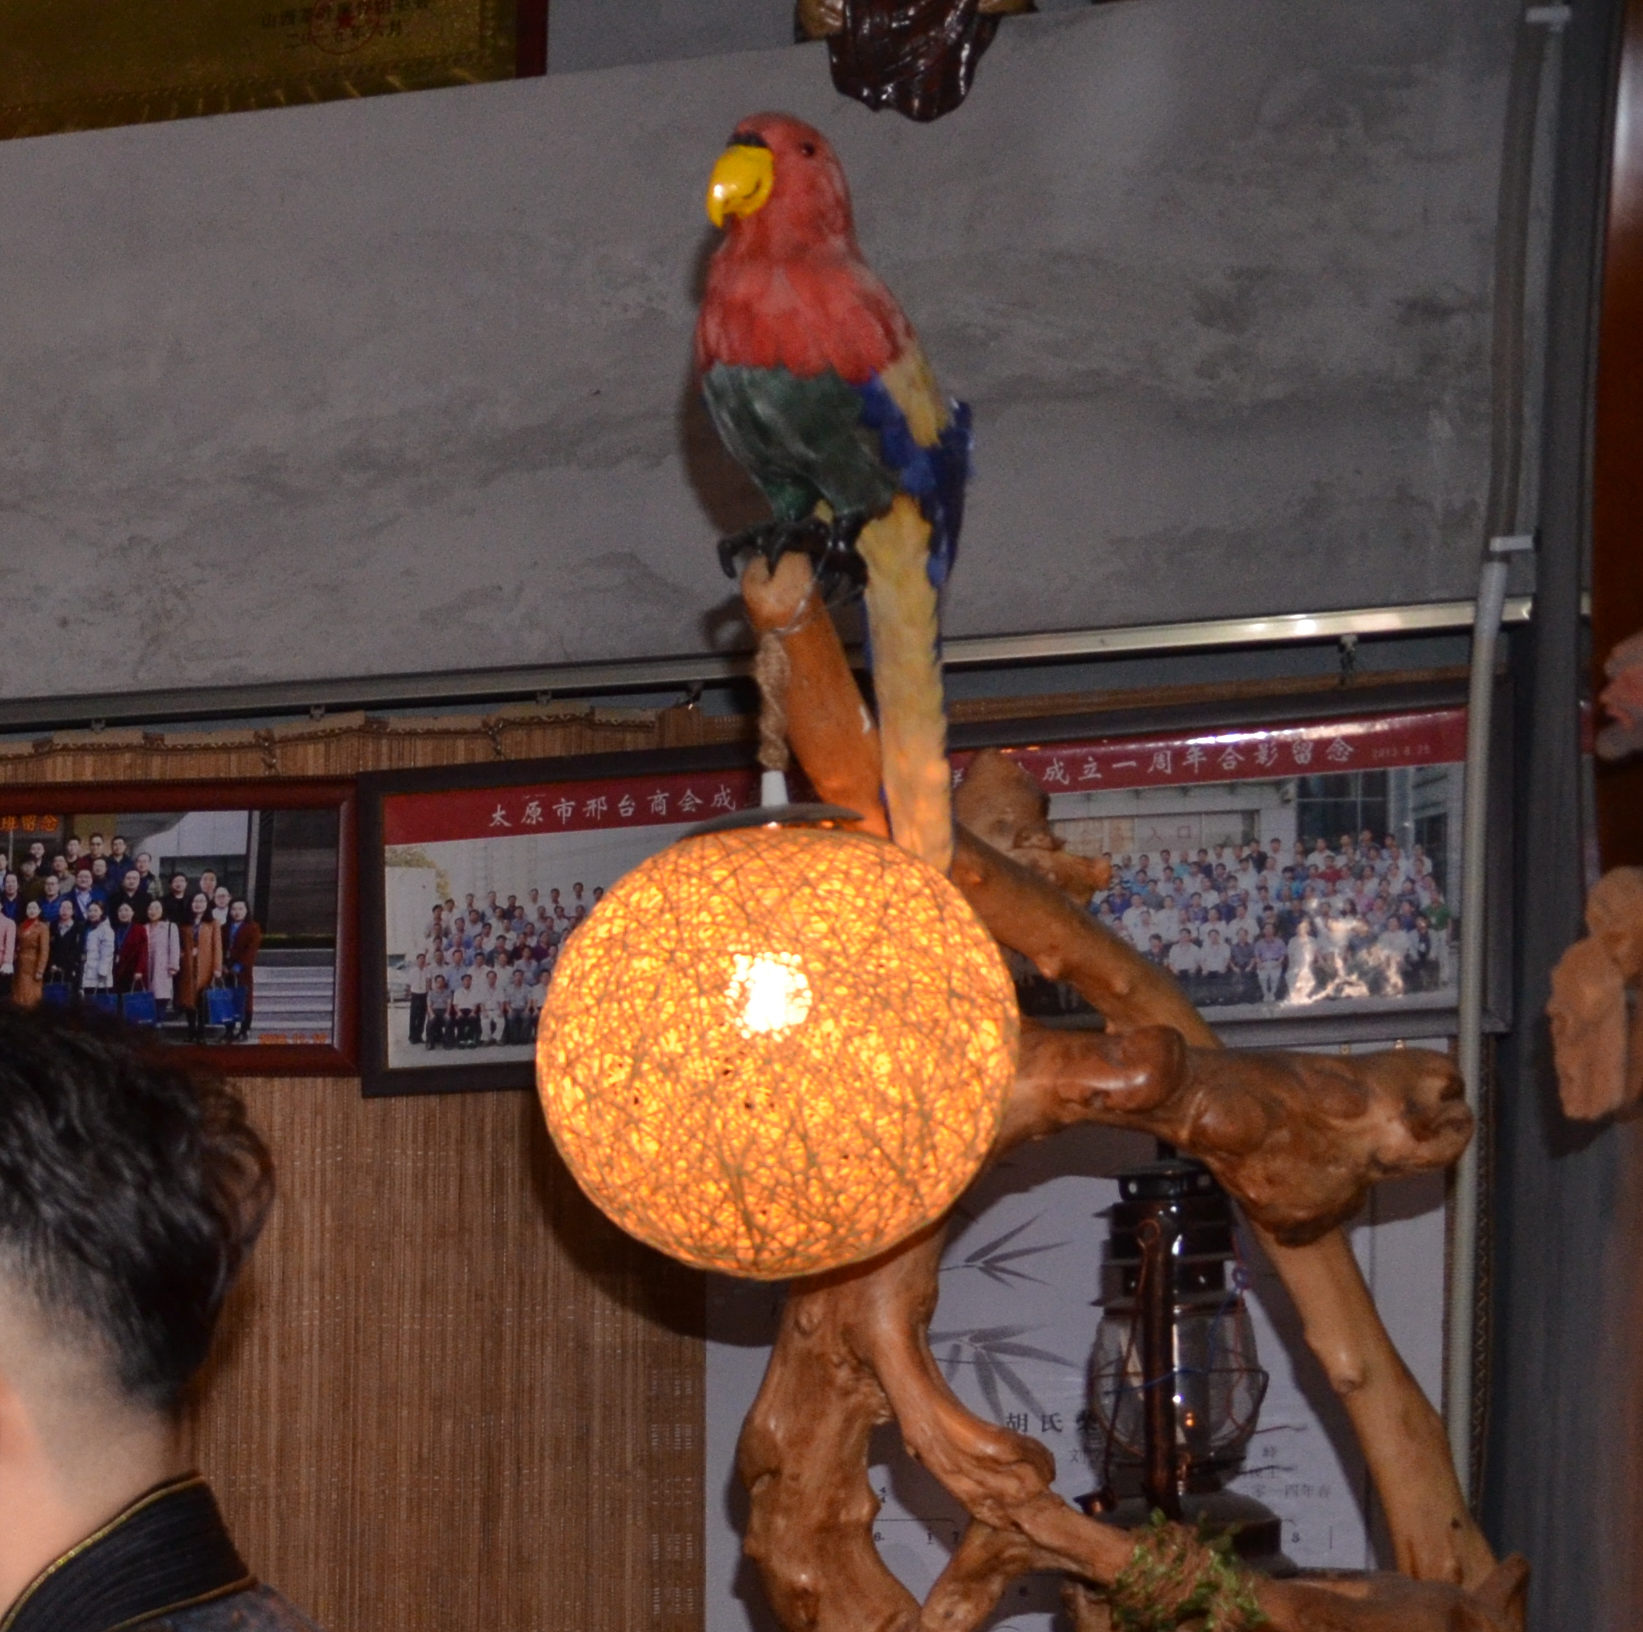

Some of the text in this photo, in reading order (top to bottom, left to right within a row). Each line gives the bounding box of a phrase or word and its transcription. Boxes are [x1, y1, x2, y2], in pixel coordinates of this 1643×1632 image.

[488, 784, 737, 828] 太原市邢台商会成
[1042, 736, 1356, 786] 成立一周年合影留念
